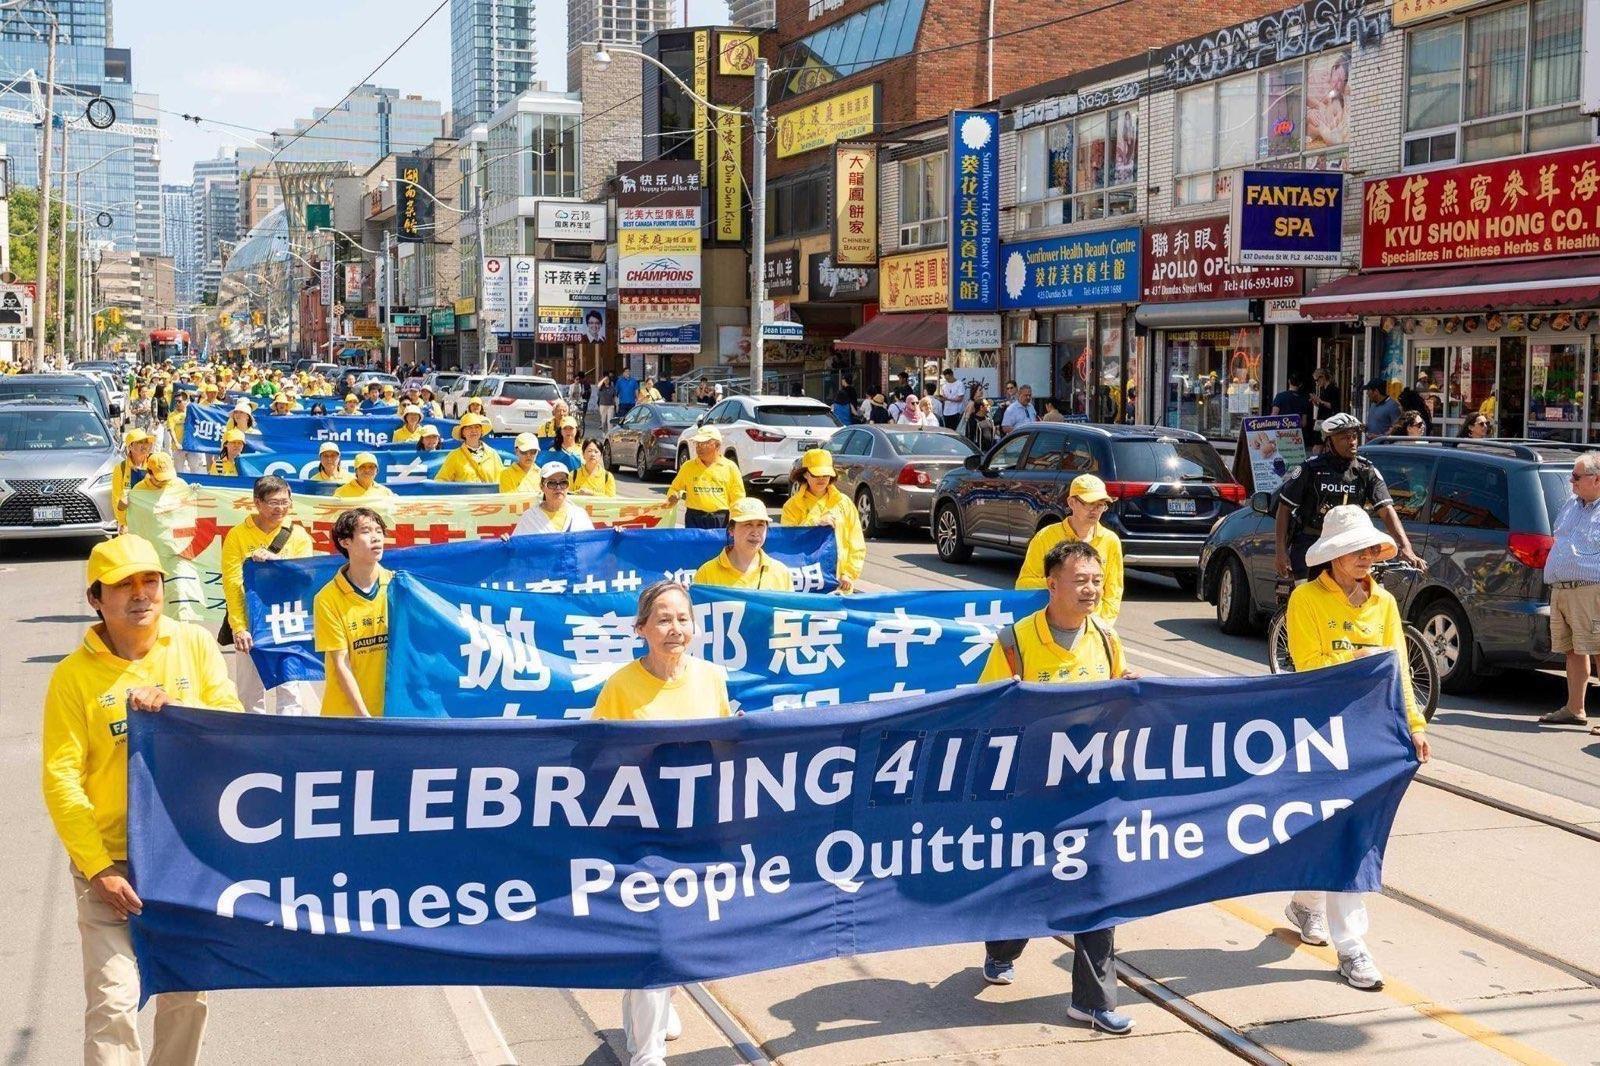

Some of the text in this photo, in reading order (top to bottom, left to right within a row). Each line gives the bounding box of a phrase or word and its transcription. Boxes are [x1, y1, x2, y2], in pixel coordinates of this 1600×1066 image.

[639, 173, 699, 186] 快乐小羊
[1246, 185, 1340, 208] FANTASY
[981, 152, 992, 304] Sunflower Health Beauty Centre
[1274, 216, 1315, 238] SPA
[1385, 207, 1588, 248] KYU SHON HONG CO.
[1026, 238, 1137, 265] Sunflower Health Beauty Centre
[1381, 249, 1440, 266] Specializes
[1456, 243, 1501, 259] Chinese
[1504, 239, 1540, 255] Herbs
[1543, 236, 1553, 250] &
[544, 270, 601, 286] 汗蒸养生
[626, 270, 694, 281] CHAMPIONS
[1151, 259, 1198, 281] APOLLO
[1223, 279, 1239, 292] Tel:
[1239, 275, 1294, 290] 416-593-0159
[1272, 299, 1297, 310] APOLLO
[764, 326, 779, 335] Jean
[779, 325, 796, 335] Lumb
[1248, 417, 1298, 431] Fantasy Spa
[356, 428, 388, 446] the
[1320, 482, 1356, 494] POLICE
[217, 715, 1350, 845] CELEBRATING 417 MILLION
[217, 872, 537, 935] Chinese
[569, 843, 791, 922] People
[815, 817, 1089, 893] Quitting
[1113, 809, 1205, 863] the
